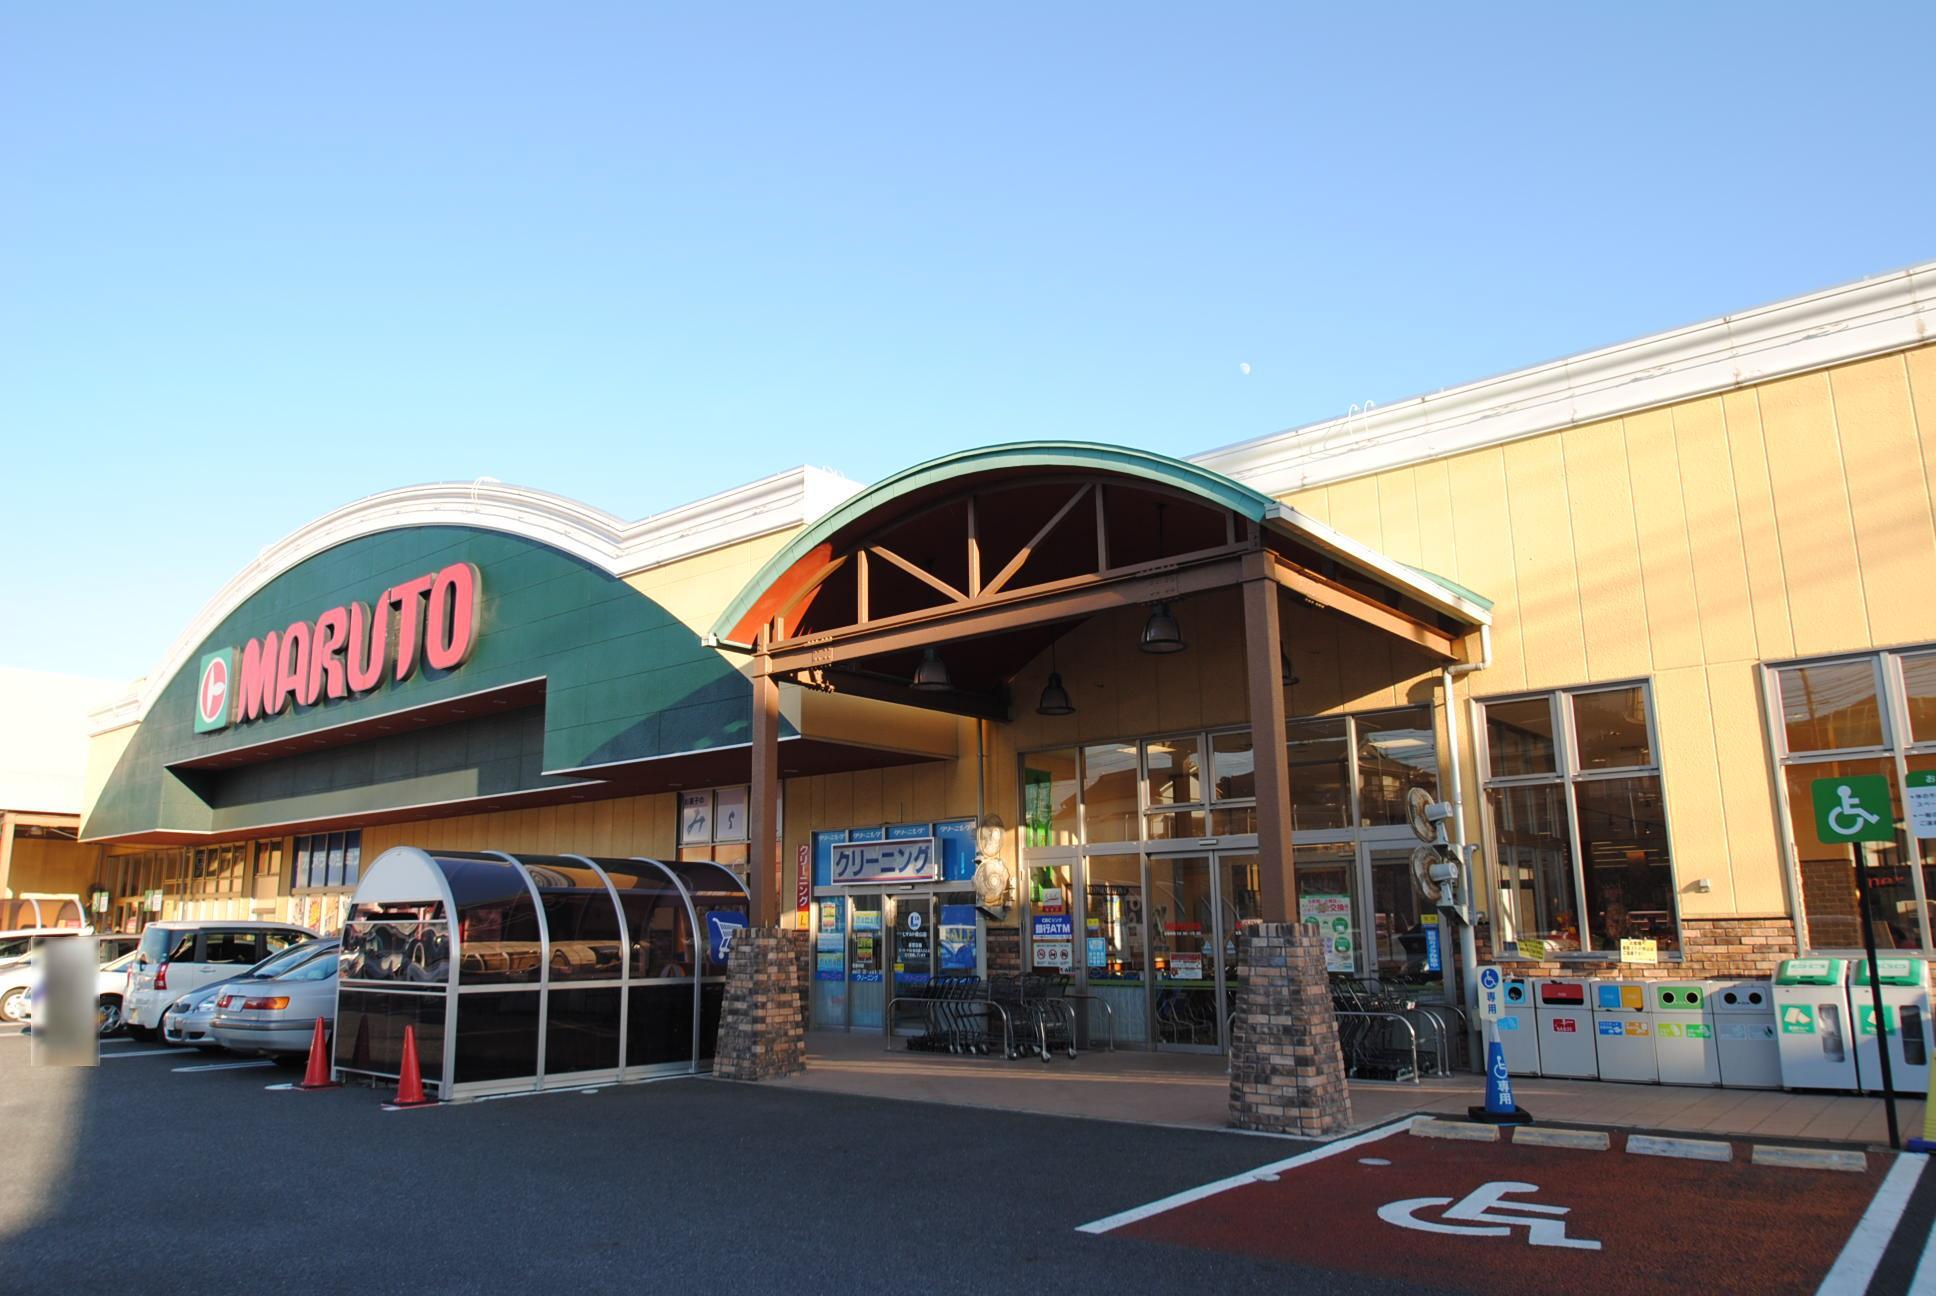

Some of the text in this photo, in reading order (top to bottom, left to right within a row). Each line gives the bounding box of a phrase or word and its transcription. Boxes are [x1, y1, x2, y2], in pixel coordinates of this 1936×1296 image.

[237, 562, 480, 724] MARUTO
[799, 844, 809, 907] クリーニング
[835, 845, 930, 878] クリーニング
[1035, 923, 1071, 934] 銀行ATM
[1486, 991, 1497, 1015] 専用
[1497, 1080, 1512, 1105] 専用
